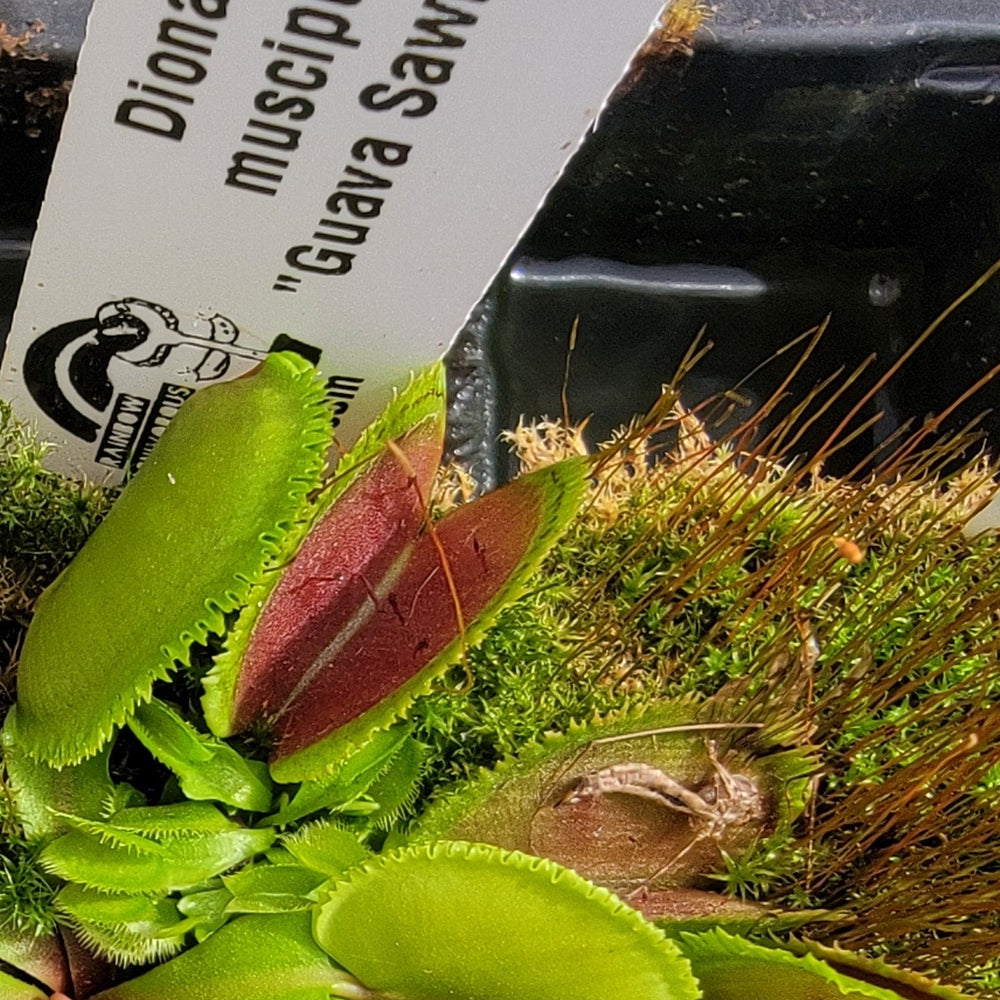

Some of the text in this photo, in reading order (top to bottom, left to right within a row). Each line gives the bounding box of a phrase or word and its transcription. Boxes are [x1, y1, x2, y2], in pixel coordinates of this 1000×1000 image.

[224, 0, 362, 198] muscip
[272, 0, 489, 294] "Guava Saw
[98, 395, 146, 469] RAINBOW
